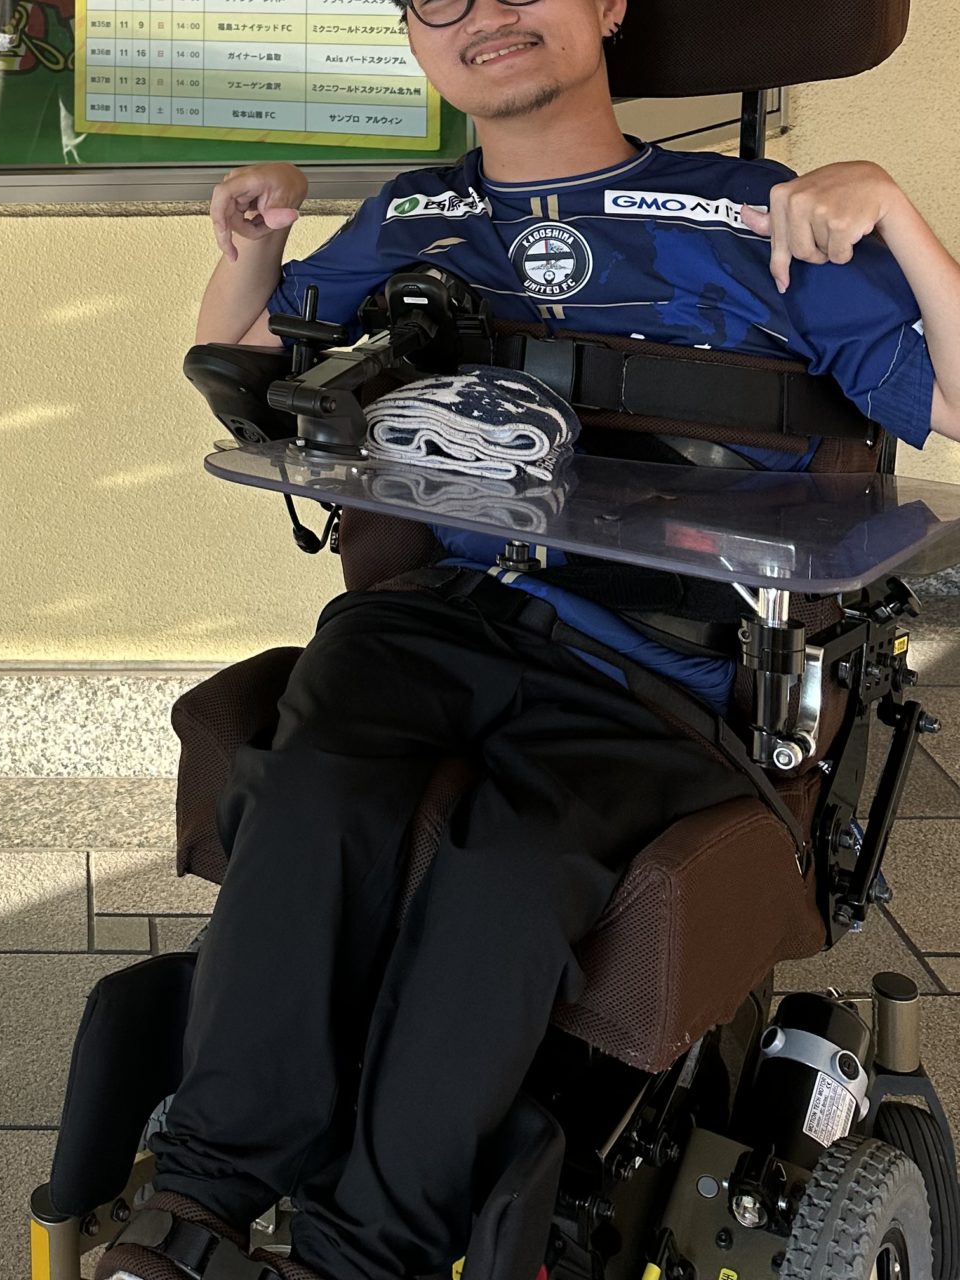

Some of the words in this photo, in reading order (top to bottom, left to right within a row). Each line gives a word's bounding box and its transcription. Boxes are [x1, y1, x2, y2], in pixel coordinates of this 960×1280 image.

[119, 20, 128, 28] 11
[138, 21, 144, 29] 9
[176, 22, 200, 30] 14:00
[281, 23, 292, 32] FC
[119, 49, 128, 57] 11
[135, 49, 146, 57] 16
[176, 50, 200, 58] 14:00
[325, 54, 343, 63] Axis
[119, 76, 128, 84] 11
[135, 77, 146, 85] 23
[176, 79, 200, 87] 14:00
[311, 83, 421, 95] ミクニワールドスタジアム北九州
[119, 104, 127, 112] 11
[135, 105, 146, 113] 29
[176, 107, 199, 115] 15:00
[264, 110, 276, 119] FC
[522, 229, 575, 247] KAGOSHIMA
[523, 279, 560, 293] UNITED
[561, 278, 576, 290] FC
[807, 1112, 818, 1132] MOTION
[813, 1096, 822, 1112] TECH
[818, 1077, 827, 1096] MOTOR
